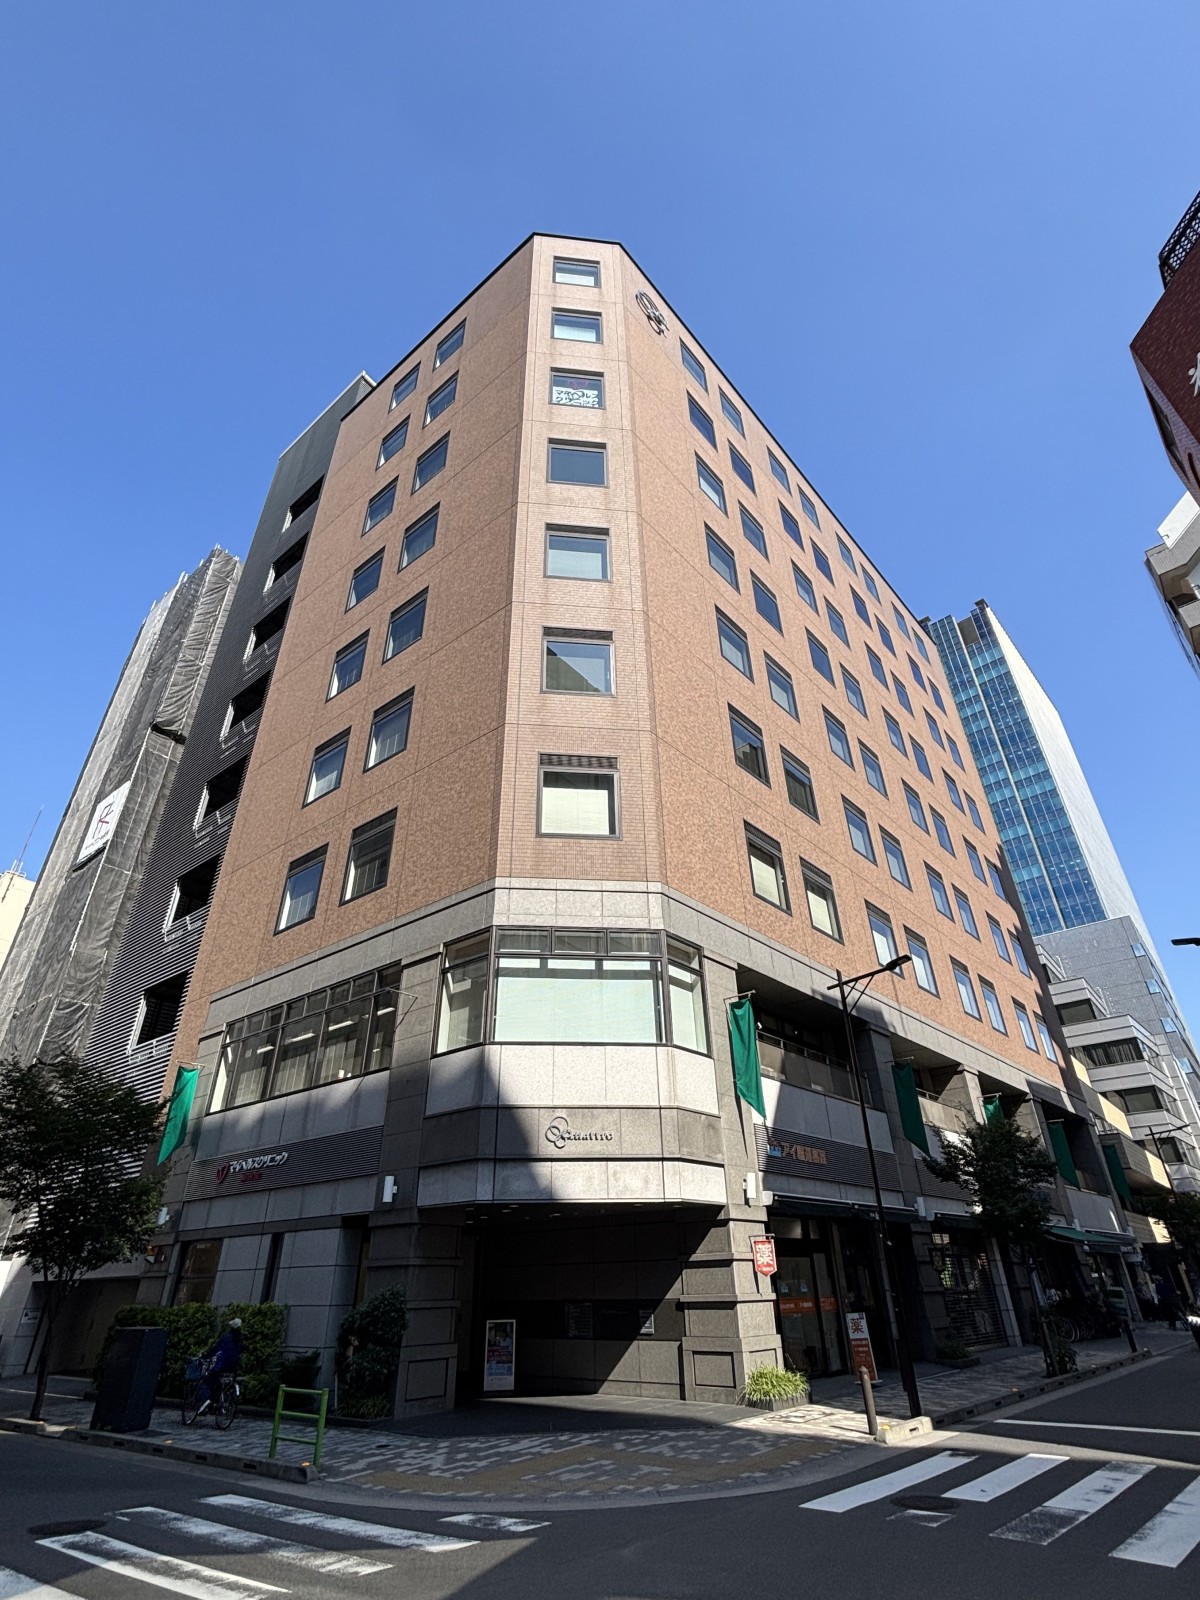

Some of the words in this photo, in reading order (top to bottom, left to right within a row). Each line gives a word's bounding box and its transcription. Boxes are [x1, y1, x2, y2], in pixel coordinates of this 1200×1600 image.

[229, 1152, 288, 1173] マイヘルスクリニック
[755, 1243, 774, 1265] 薬
[849, 1317, 865, 1334] 薬
